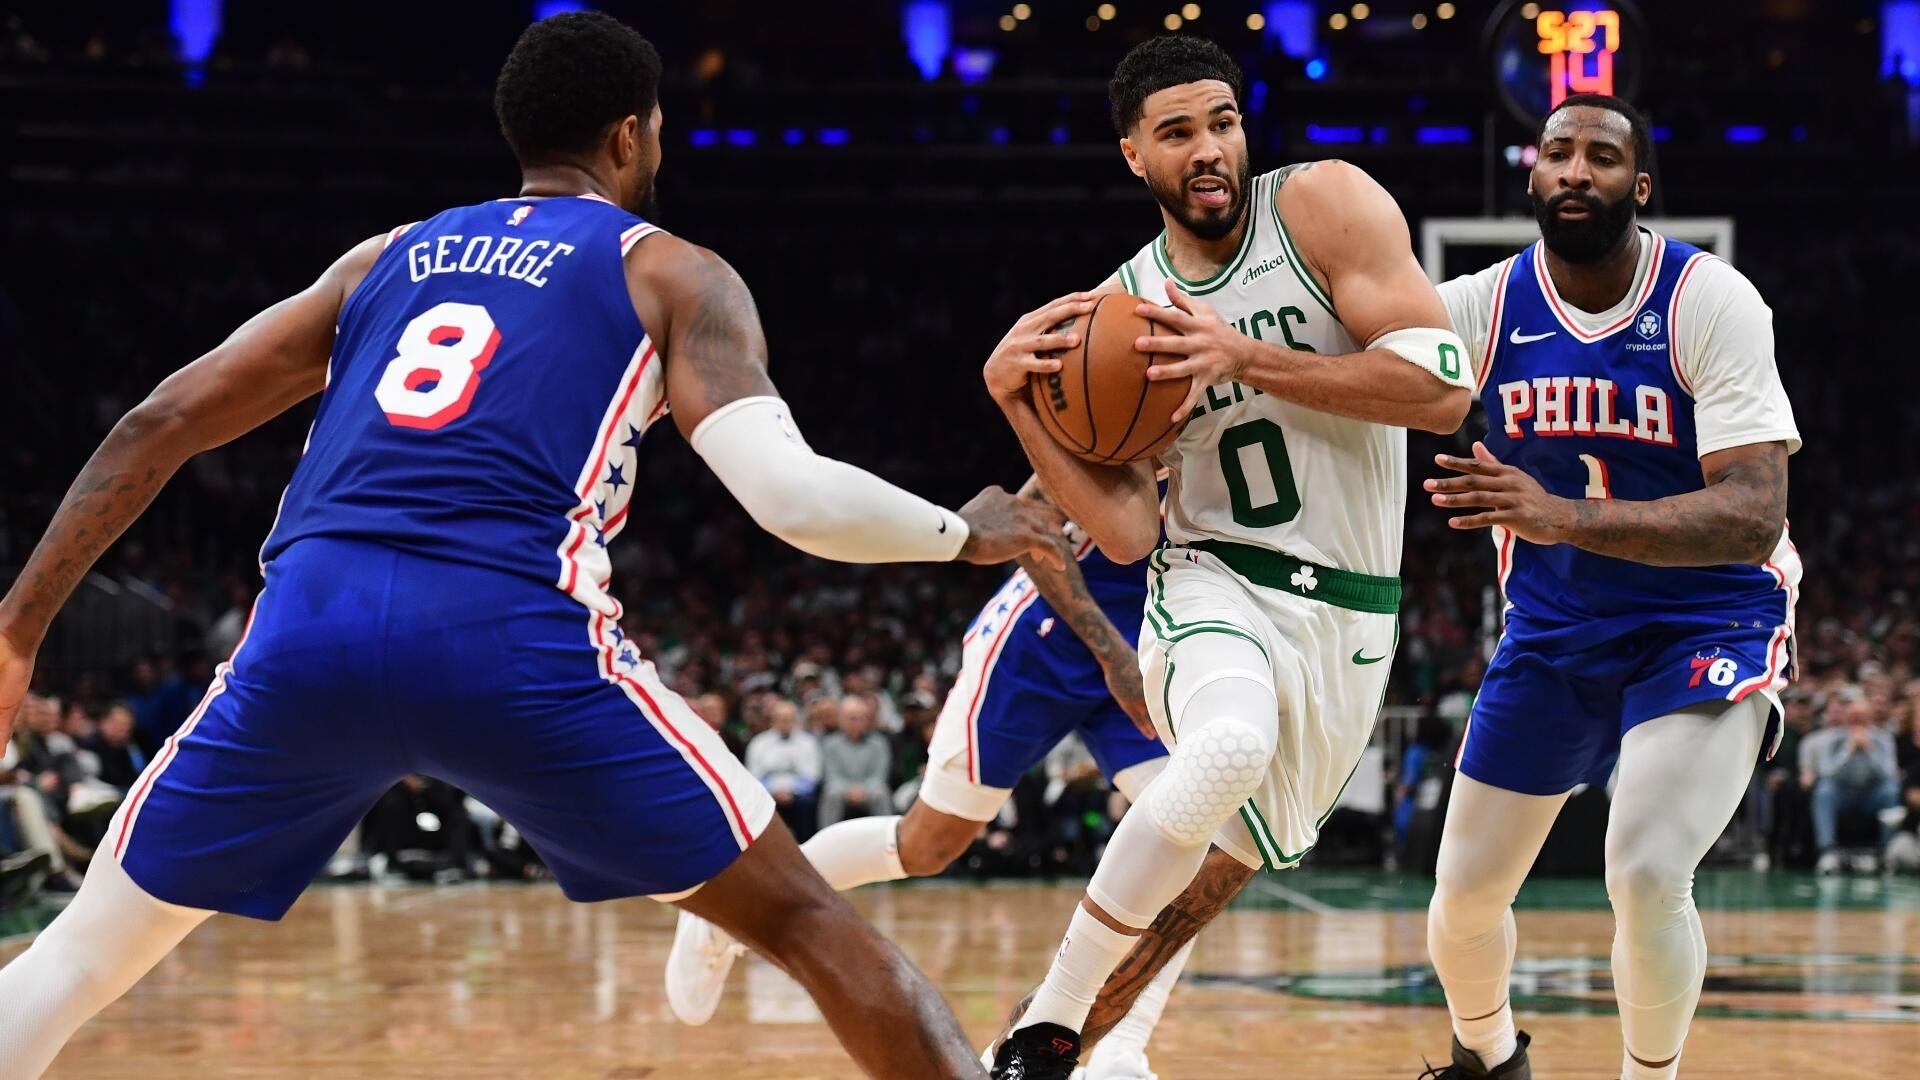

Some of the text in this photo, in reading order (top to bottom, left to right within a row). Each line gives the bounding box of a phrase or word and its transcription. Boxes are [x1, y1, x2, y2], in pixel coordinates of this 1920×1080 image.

[1550, 49, 1613, 110] 14
[408, 234, 575, 288] GEORGE
[1242, 254, 1285, 286] Amica
[374, 301, 502, 431] 8
[1437, 342, 1460, 380] 0
[1498, 376, 1678, 447] PHILA
[1218, 418, 1302, 529] 0
[1578, 453, 1613, 500] 1
[1688, 656, 1738, 688] 76
